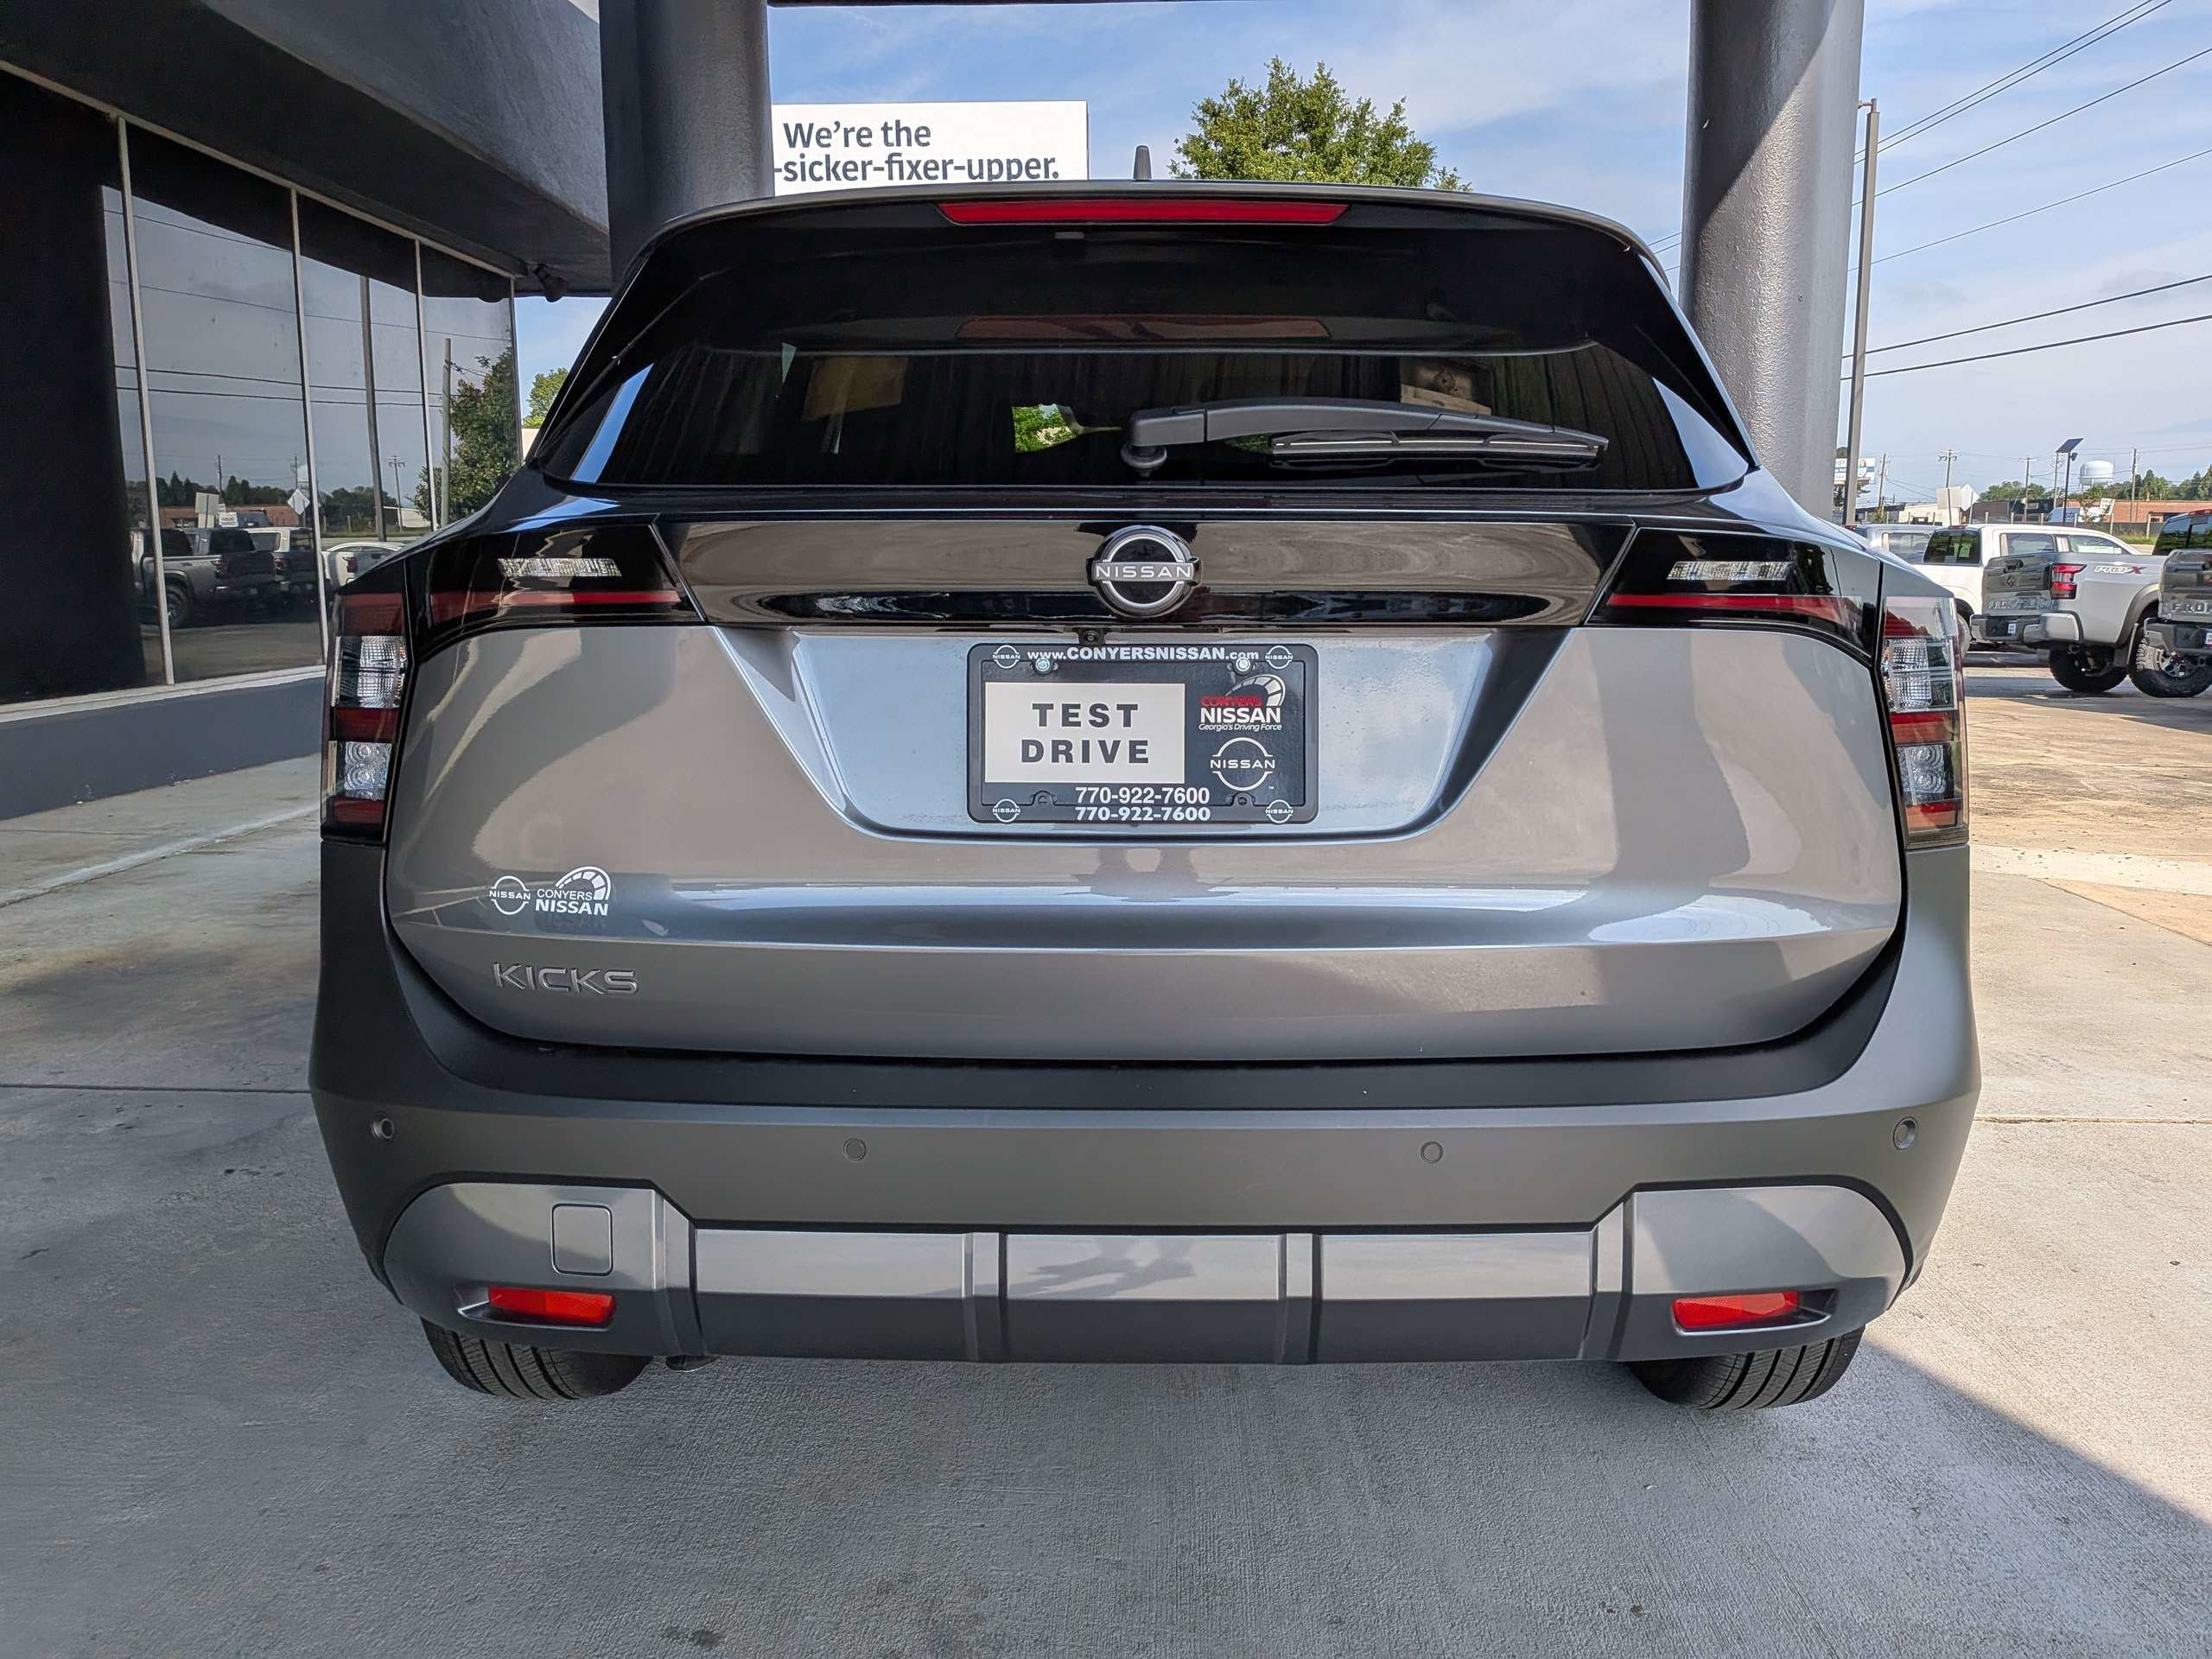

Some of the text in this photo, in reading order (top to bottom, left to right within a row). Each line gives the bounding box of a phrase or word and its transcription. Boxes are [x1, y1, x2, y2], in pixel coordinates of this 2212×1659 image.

[783, 119, 931, 149] We’re the
[1096, 564, 1192, 578] NISSAN
[1027, 646, 1260, 661] www.CONYERSNISSAN.com
[1200, 696, 1262, 707] CONYERS
[1031, 702, 1139, 728] TEST
[1200, 707, 1281, 723] NISSAN
[1198, 723, 1283, 733] Georgia's Driving Force
[1020, 739, 1149, 765] DRIVE
[1210, 759, 1276, 769] NISSAN
[1075, 786, 1211, 804] 770-922-7600
[1075, 806, 1211, 822] 770-922-7600
[489, 889, 531, 900] NISSAN
[537, 887, 594, 901] CONYERS
[535, 899, 609, 916] NISSAN
[493, 961, 639, 995] KICKS
